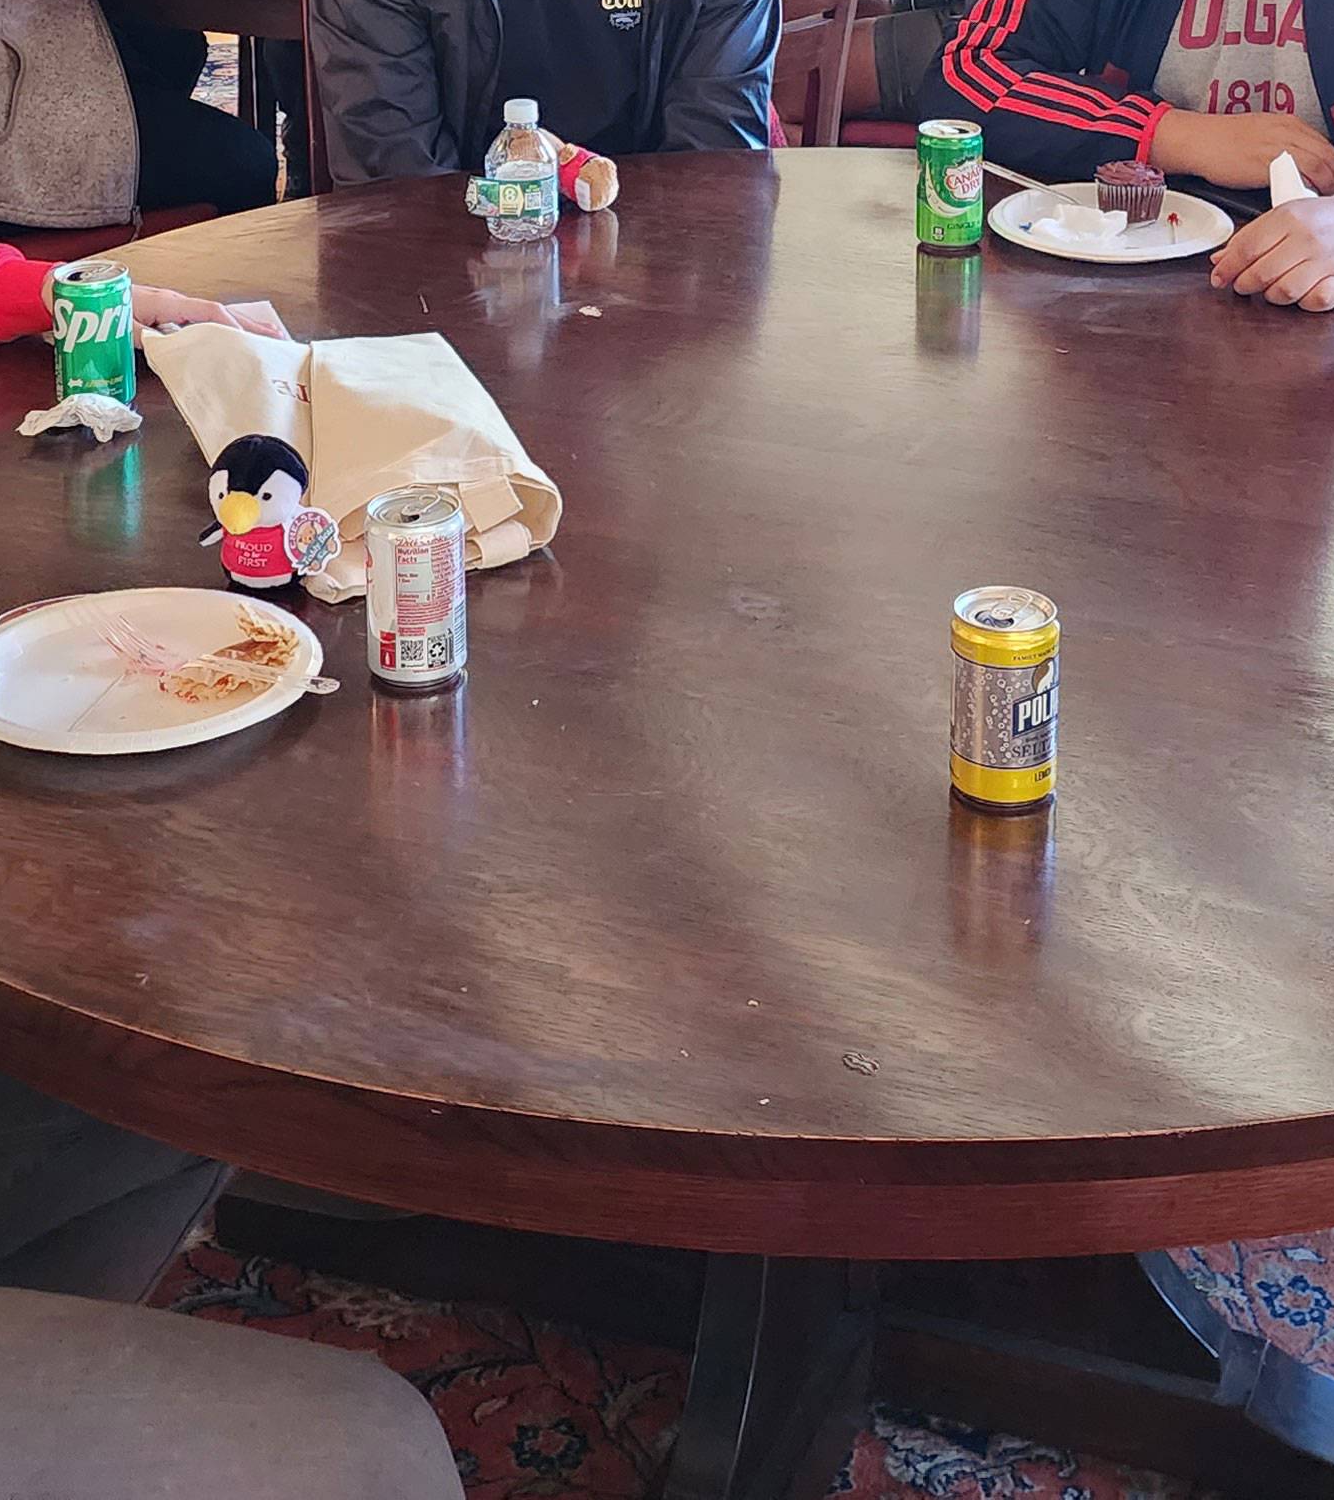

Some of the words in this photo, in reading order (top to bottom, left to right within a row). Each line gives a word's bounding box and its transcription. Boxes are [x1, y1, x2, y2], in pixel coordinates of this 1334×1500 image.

[1208, 78, 1295, 114] 1819
[235, 540, 273, 553] PROUD
[238, 556, 268, 568] FIRST
[1018, 692, 1052, 732] POL
